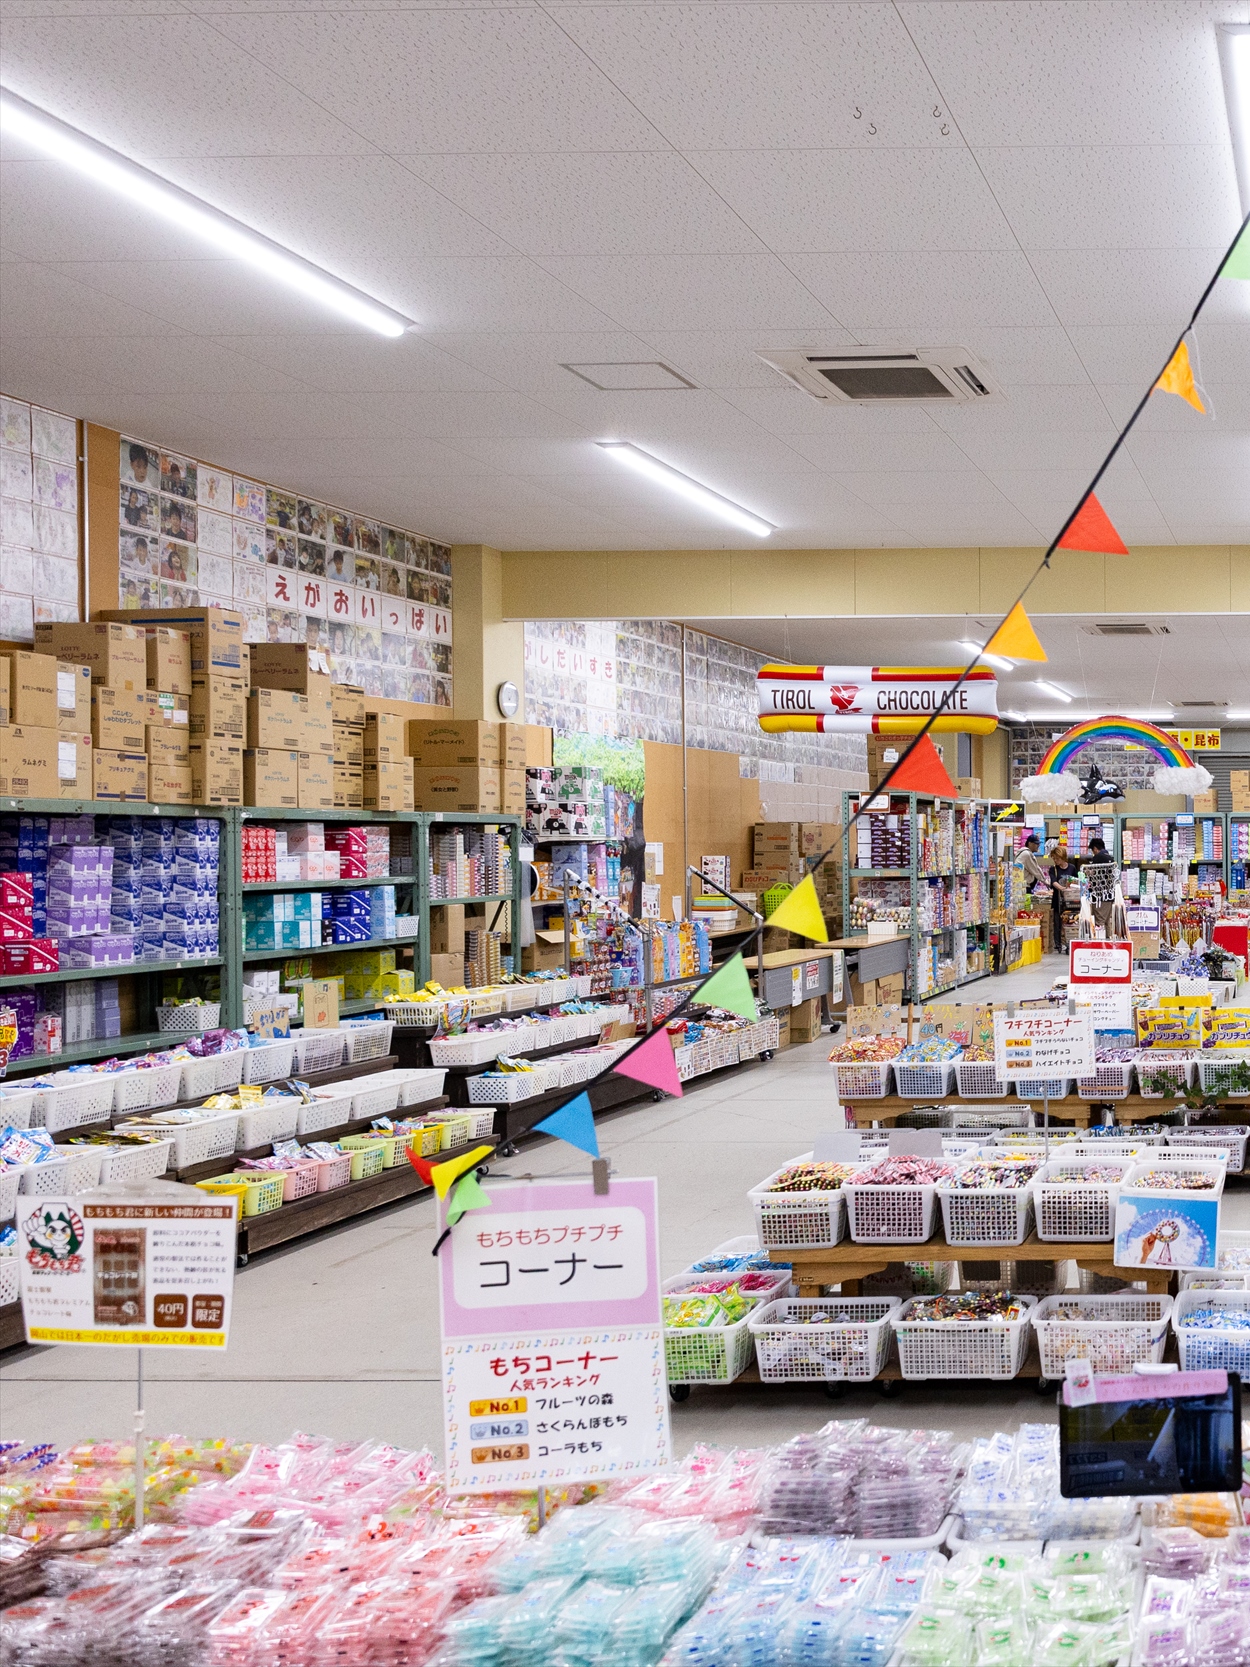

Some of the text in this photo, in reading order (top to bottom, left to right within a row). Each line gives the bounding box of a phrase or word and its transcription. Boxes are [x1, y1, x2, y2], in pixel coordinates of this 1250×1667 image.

[274, 574, 448, 635] えがおいっぱい
[771, 689, 968, 710] TIROL CHOCOLATE
[22, 758, 47, 766] ラムネグミ
[1080, 964, 1122, 974] コーナー
[920, 1022, 944, 1037] 40円
[1004, 1018, 1083, 1030] プチプチコーナー
[1023, 1029, 1065, 1037] 人気ランキング
[1148, 1031, 1190, 1041] ガブリチュウ
[1036, 1059, 1083, 1067] ハイエイトチョコ
[477, 1224, 624, 1248] もちもちプチプチ
[480, 1252, 624, 1288] コーナー
[157, 1303, 185, 1315] 40円
[195, 1309, 221, 1322] 限定
[490, 1351, 619, 1376] もちコーナー
[510, 1374, 601, 1392] 人気ランキング
[490, 1393, 614, 1413] No.1 フルーツの森
[491, 1415, 629, 1437] No.2 さくらんぼもち
[491, 1440, 603, 1460] No.3 コーラもち
